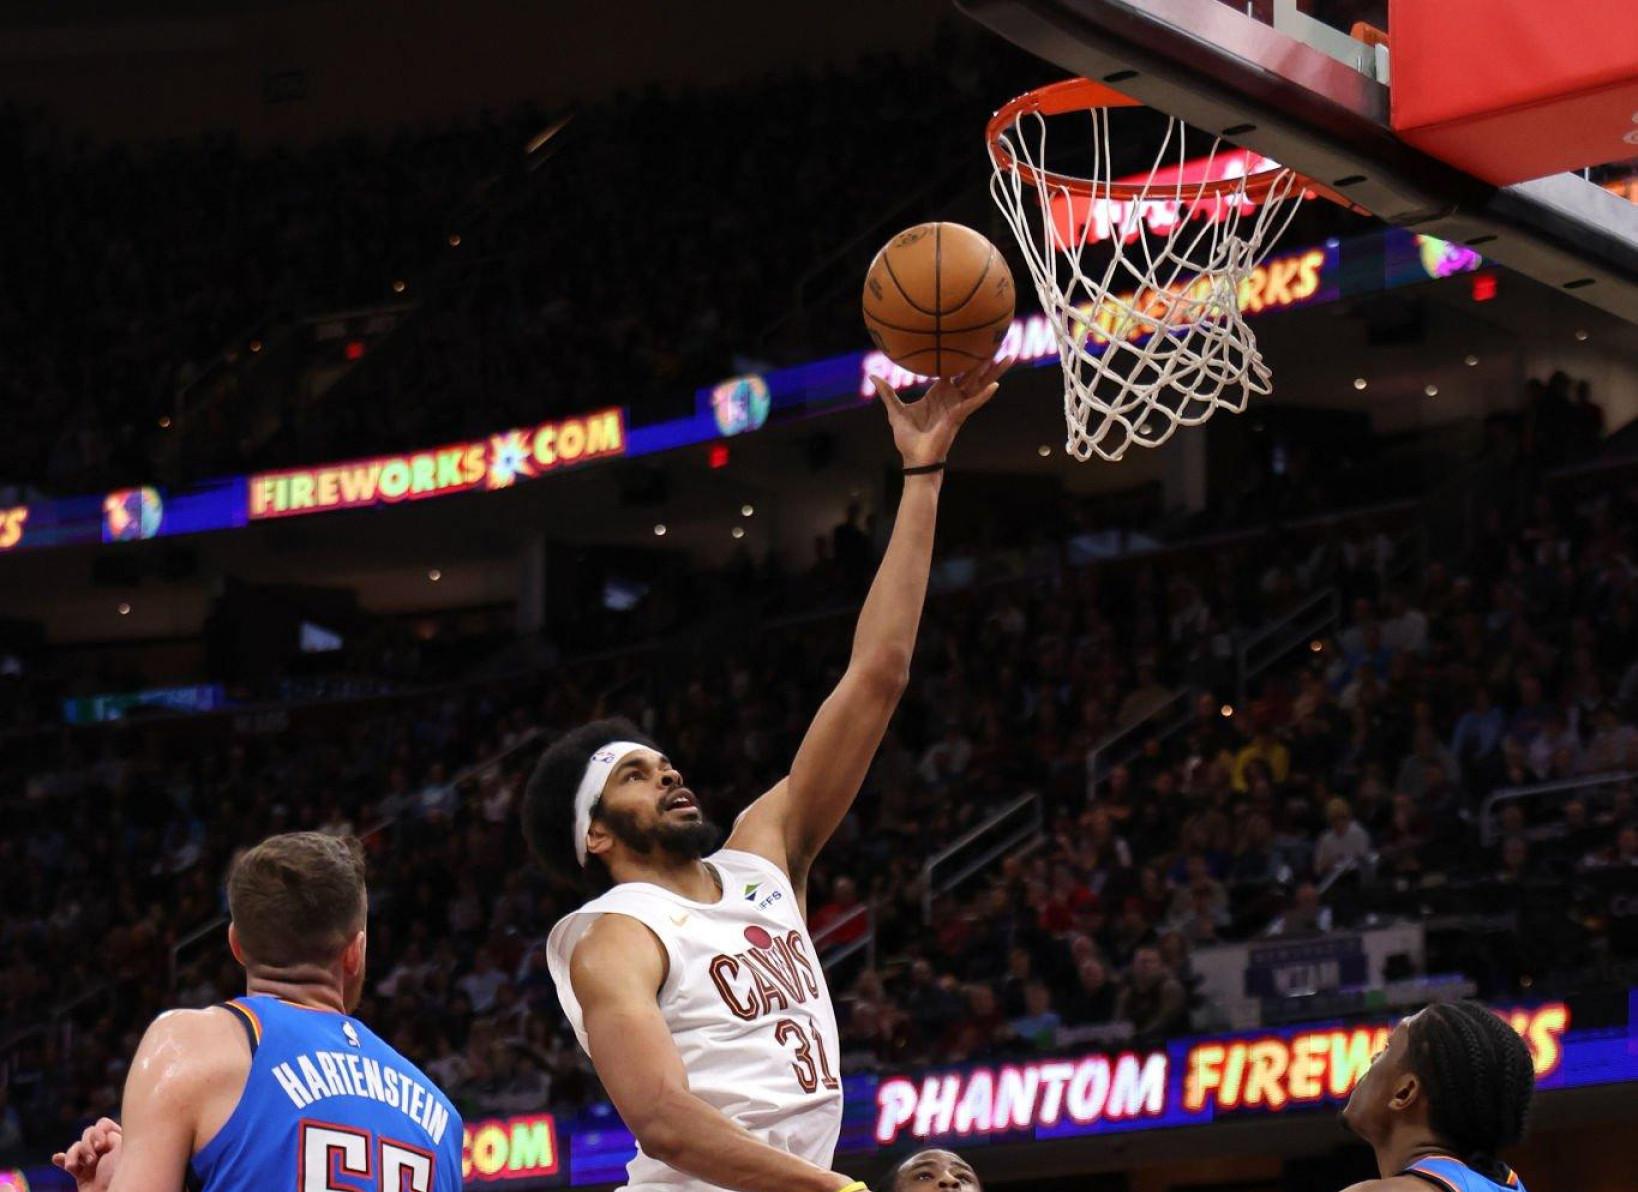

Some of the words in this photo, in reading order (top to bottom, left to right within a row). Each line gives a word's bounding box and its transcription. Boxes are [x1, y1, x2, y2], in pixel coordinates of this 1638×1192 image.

[252, 444, 486, 515] FIREWORKS
[709, 930, 819, 1021] CAVS
[272, 1051, 449, 1145] HARTENSTEIN
[775, 1018, 840, 1093] 31
[877, 1053, 1167, 1140] PHANTOM
